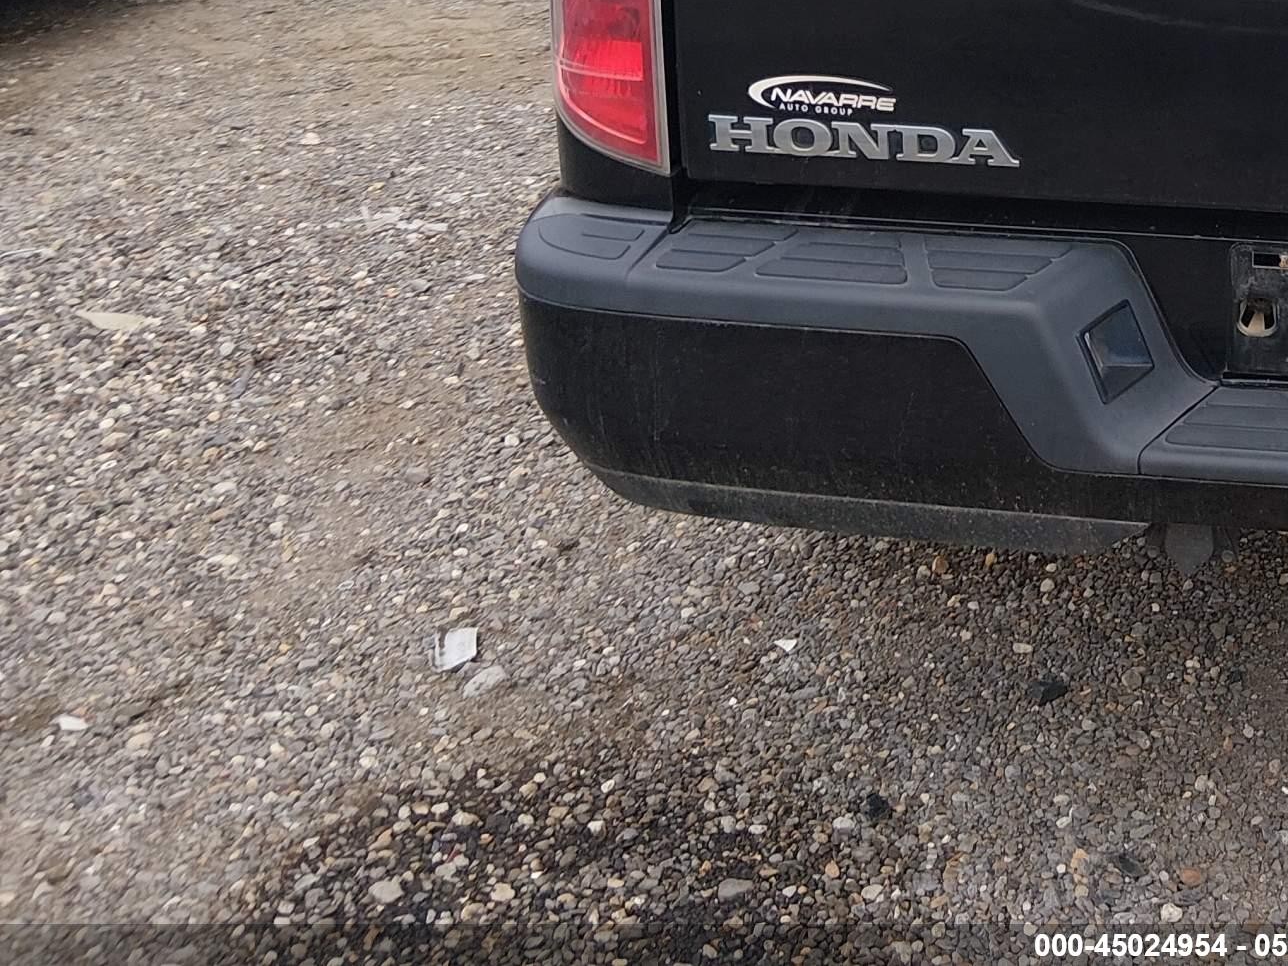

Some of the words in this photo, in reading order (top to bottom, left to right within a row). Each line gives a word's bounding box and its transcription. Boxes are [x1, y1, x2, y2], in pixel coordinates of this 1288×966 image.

[770, 86, 897, 112] NAVARRE
[779, 102, 809, 114] AUTO
[815, 105, 853, 117] GROUP
[708, 113, 1020, 168] HONDA
